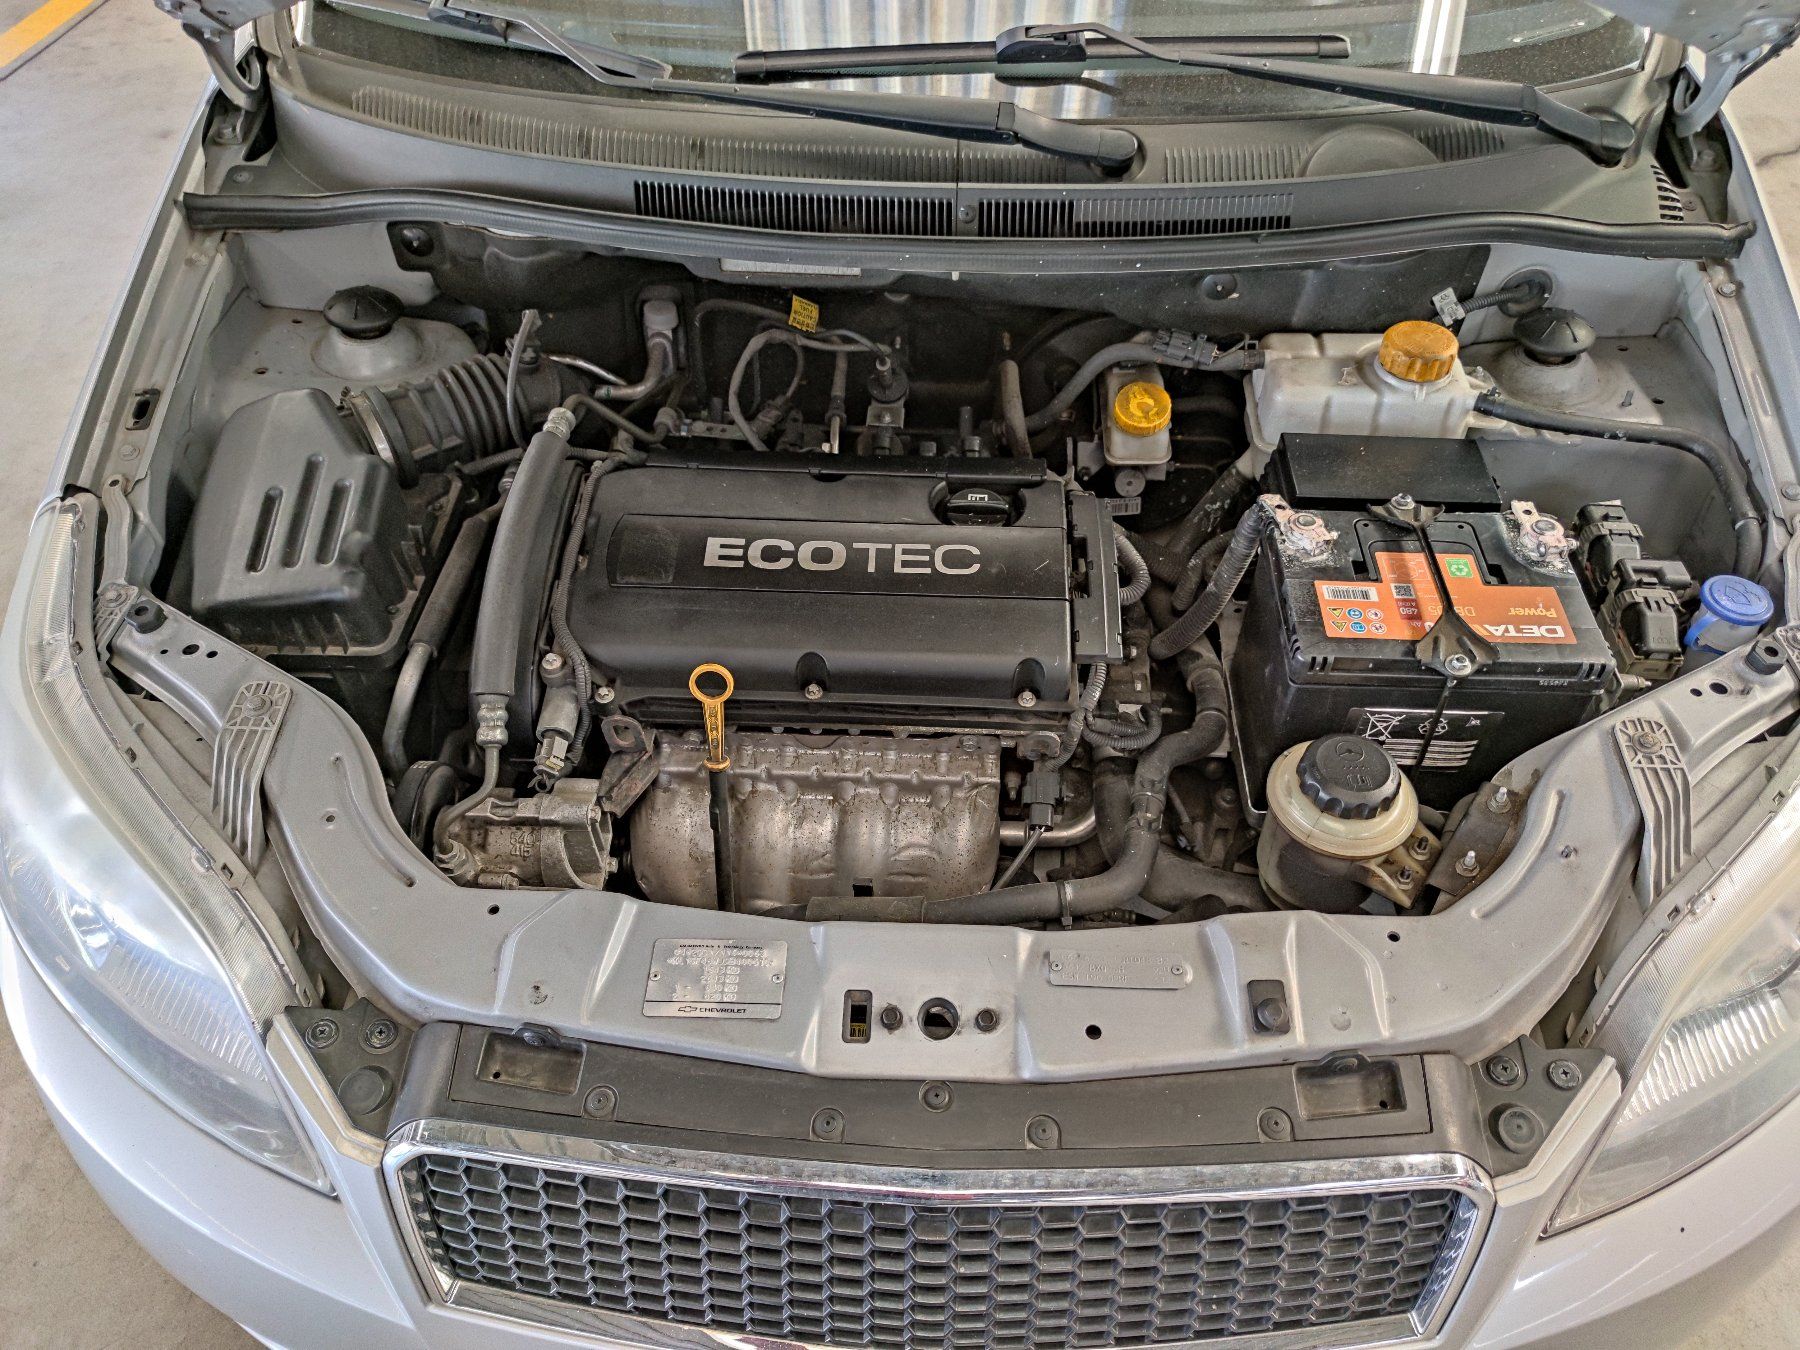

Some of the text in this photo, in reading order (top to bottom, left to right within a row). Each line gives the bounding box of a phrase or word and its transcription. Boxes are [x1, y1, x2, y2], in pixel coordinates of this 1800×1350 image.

[703, 536, 981, 575] ECOTEC
[1399, 607, 1418, 615] 480
[1428, 605, 1476, 617] DB05
[1507, 607, 1557, 618] Power
[1488, 624, 1566, 638] DETA
